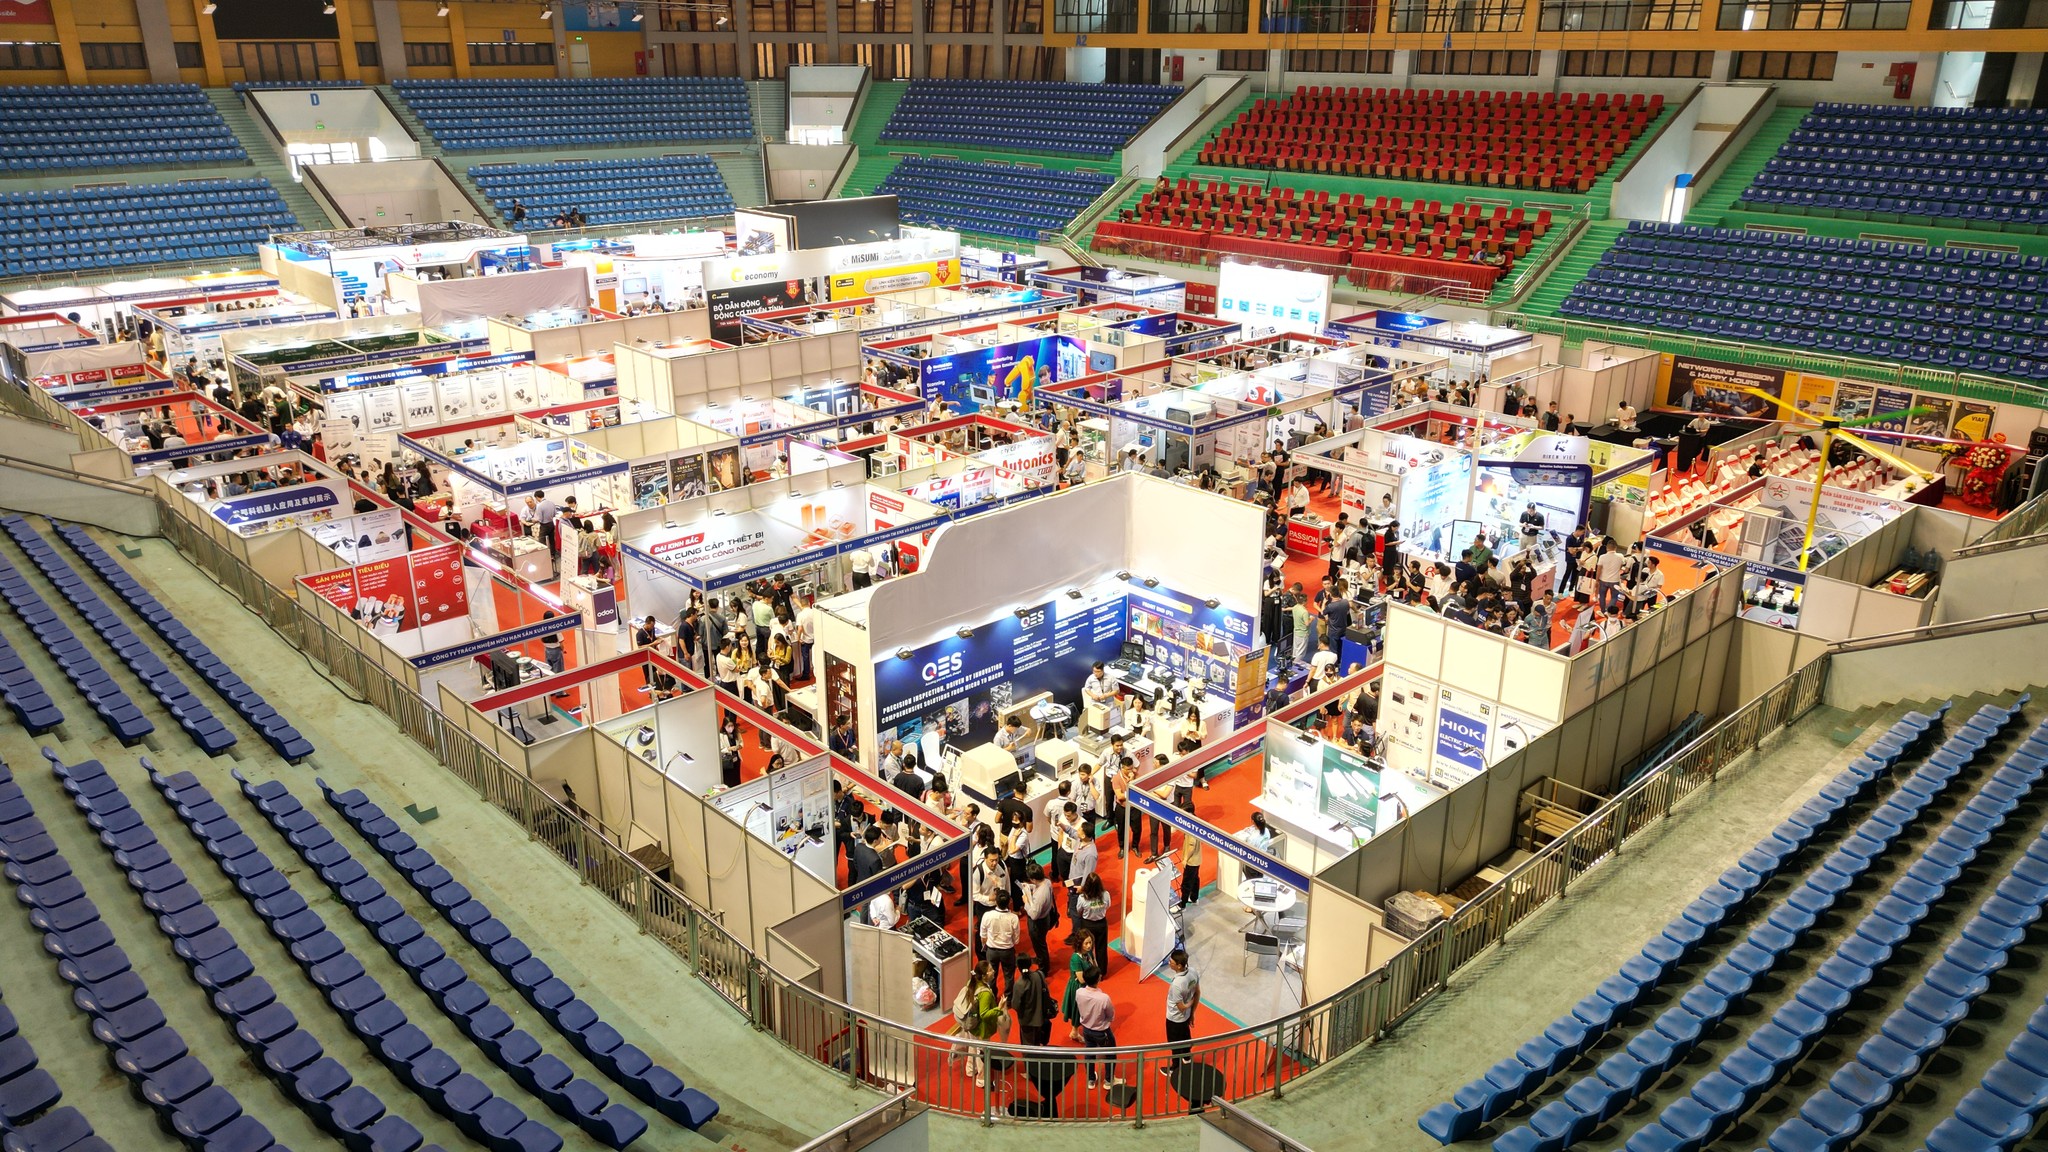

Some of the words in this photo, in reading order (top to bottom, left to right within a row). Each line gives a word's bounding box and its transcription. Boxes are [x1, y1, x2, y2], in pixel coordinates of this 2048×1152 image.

[503, 29, 516, 42] D1
[1076, 34, 1088, 46] A2
[310, 93, 320, 106] D
[852, 252, 878, 264] MiSUMi
[744, 271, 778, 280] economy
[938, 270, 946, 278] 70
[713, 304, 723, 312] BỘ
[740, 300, 760, 308] ĐỘNG
[714, 312, 734, 320] ĐỘNG
[501, 354, 526, 363] VIETNAM
[395, 368, 422, 378] VIETNAM
[1678, 362, 1734, 376] NETWORKING
[1736, 371, 1774, 382] SESSION
[1698, 372, 1728, 382] HAPPY
[1729, 377, 1760, 387] HOURS
[1003, 451, 1054, 472] Autonics
[1288, 530, 1318, 544] PASSION
[654, 544, 667, 554] ĐẠI
[668, 542, 684, 550] KINH
[686, 536, 700, 546] BẮC
[674, 546, 702, 560] CUNG
[704, 542, 724, 551] CẤP
[727, 534, 752, 546] THIẾT
[686, 554, 710, 565] ĐỘNG
[712, 548, 734, 558] CÔNG
[736, 540, 765, 552] NGHIỆP
[1683, 546, 1698, 554] CÔNG
[1712, 552, 1726, 561] PHẦN
[1728, 555, 1738, 564] SẢN
[1752, 562, 1766, 570] DỊCH
[358, 566, 373, 575] TIÊU
[374, 562, 390, 572] BIỂU
[757, 566, 770, 574] TNHH
[316, 574, 330, 584] SẢN
[331, 570, 352, 580] PHẨM
[597, 608, 614, 618] odoo
[1020, 610, 1045, 628] QES
[1223, 616, 1248, 633] QES
[432, 652, 450, 662] CÔNG
[456, 644, 476, 656] TRÁCH
[476, 640, 496, 652] NHIỆM
[496, 636, 508, 646] HỮU
[509, 634, 522, 644] HẠN
[522, 630, 534, 640] SẢN
[534, 626, 548, 636] XUẤT
[548, 622, 564, 632] NGỌC
[564, 619, 574, 627] LAN
[922, 652, 963, 682] QES
[882, 698, 912, 714] PRECISION
[912, 686, 946, 702] INSPECTION,
[946, 678, 964, 690] DRIVEN
[966, 674, 972, 682] BY
[973, 662, 1002, 680] INNOVATION
[882, 704, 922, 724] COMPREHENSIVE
[924, 692, 950, 708] SOLUTIONS
[951, 684, 964, 696] FROM
[964, 678, 980, 691] MICRO
[981, 676, 988, 684] TO
[988, 670, 1004, 682] MACRO
[1218, 710, 1232, 721] QES
[1441, 718, 1486, 743] HIOKI
[1440, 732, 1462, 746] ELECTRIC
[1140, 797, 1150, 807] 228
[1175, 815, 1191, 829] CÔNG
[1191, 824, 1200, 832] TY
[1200, 828, 1208, 836] CP
[1207, 832, 1224, 846] CÔNG
[1224, 841, 1248, 858] NGHIỆP
[1248, 852, 1269, 868] DUTUS
[890, 871, 908, 882] NHAT
[908, 862, 924, 875] MINH
